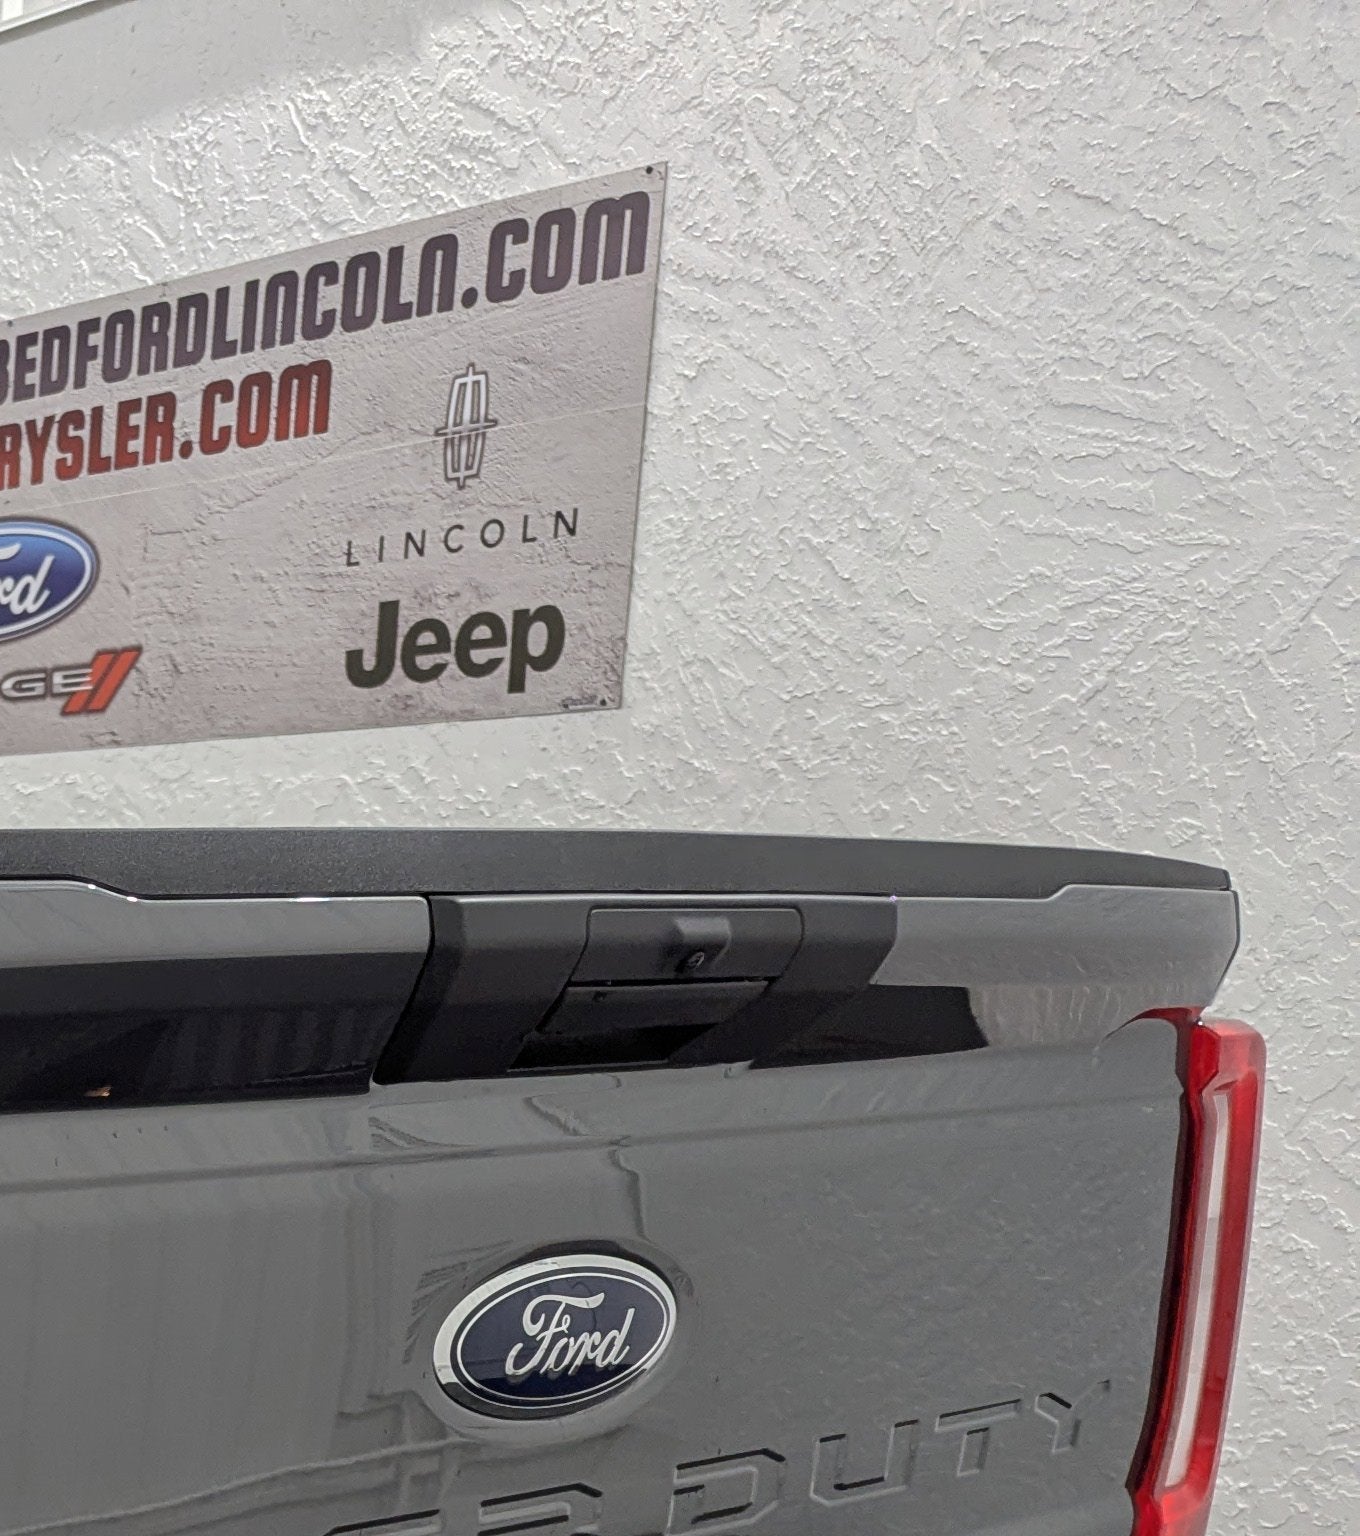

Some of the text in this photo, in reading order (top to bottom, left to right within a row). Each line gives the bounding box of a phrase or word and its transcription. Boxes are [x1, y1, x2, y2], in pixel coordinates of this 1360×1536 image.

[345, 507, 579, 568] LINCOLN
[345, 600, 566, 694] Jeep
[504, 1292, 636, 1377] Ford
